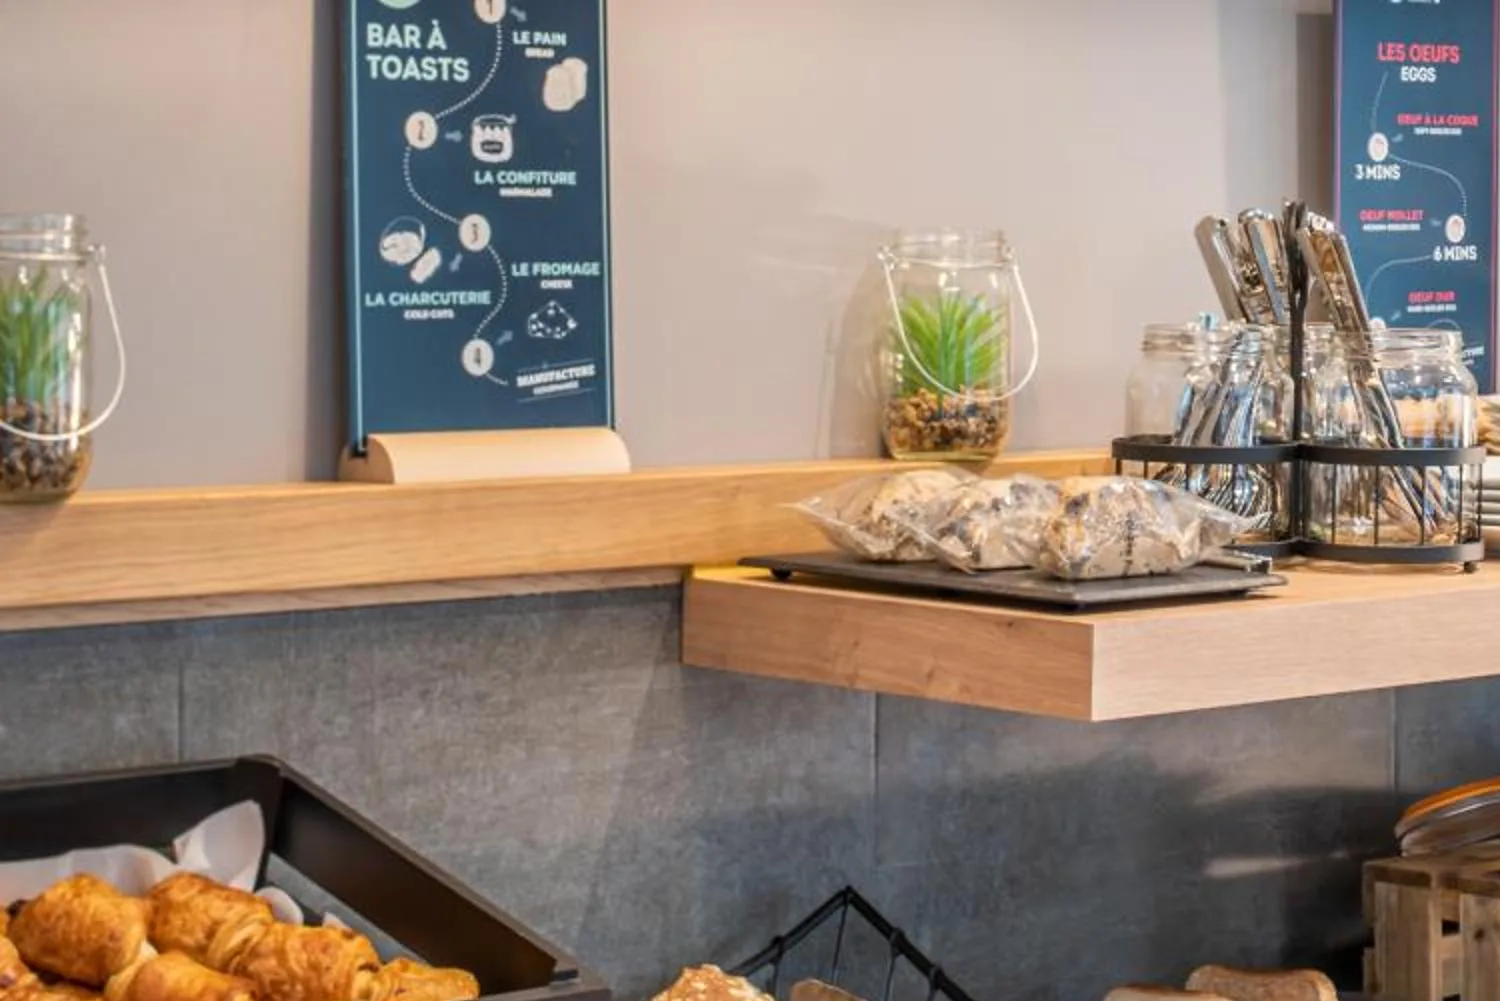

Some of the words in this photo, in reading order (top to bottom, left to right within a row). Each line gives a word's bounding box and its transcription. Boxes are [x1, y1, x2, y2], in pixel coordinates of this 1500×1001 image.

[366, 22, 421, 48] BAR
[427, 18, 447, 50] À
[512, 30, 531, 45] LE
[533, 31, 567, 46] PAIN
[1377, 41, 1406, 61] LES
[1408, 44, 1461, 64] OEUFS
[365, 54, 471, 82] TOASTS
[1400, 65, 1437, 83] EGGS
[474, 170, 494, 185] LA
[496, 170, 578, 186] CONFITURE
[1354, 164, 1364, 180] 3
[1365, 164, 1400, 180] MINS
[1433, 246, 1442, 261] 6
[1443, 245, 1477, 261] MINS
[511, 262, 529, 277] LE
[532, 261, 600, 277] FROMAGE
[364, 292, 385, 307] LA
[388, 290, 491, 307] CHARCUTERIE
